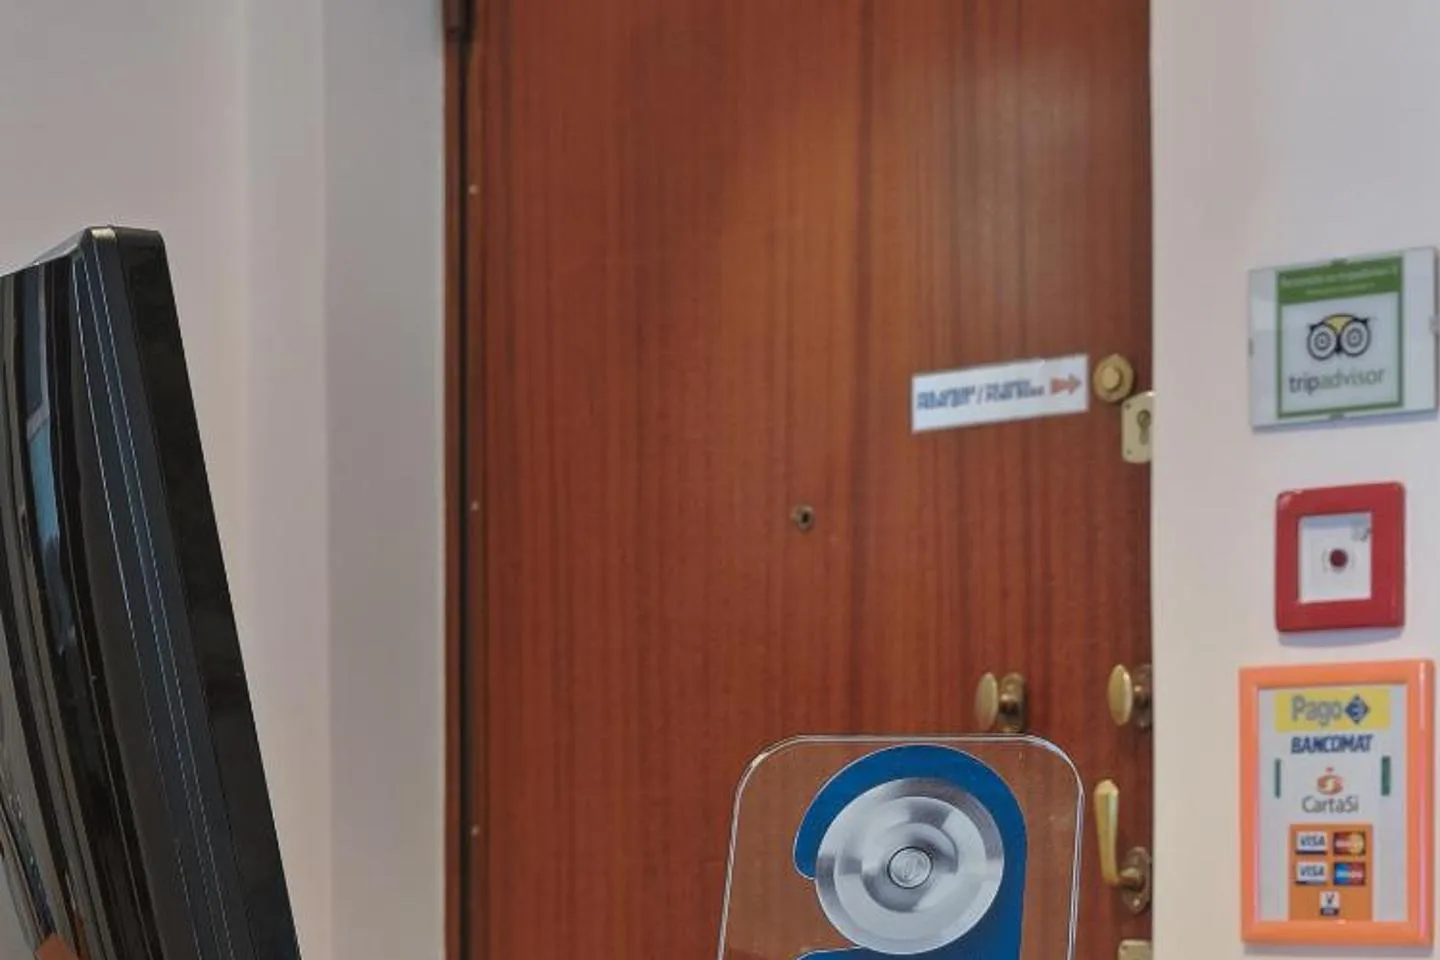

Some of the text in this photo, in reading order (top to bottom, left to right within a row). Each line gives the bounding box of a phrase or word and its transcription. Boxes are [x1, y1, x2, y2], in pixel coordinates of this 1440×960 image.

[1288, 366, 1385, 395] tripadvisor
[1291, 695, 1343, 727] Pago
[1291, 733, 1374, 754] BANCOMAT
[1301, 796, 1359, 814] CartaSi
[1300, 835, 1325, 847] VISA
